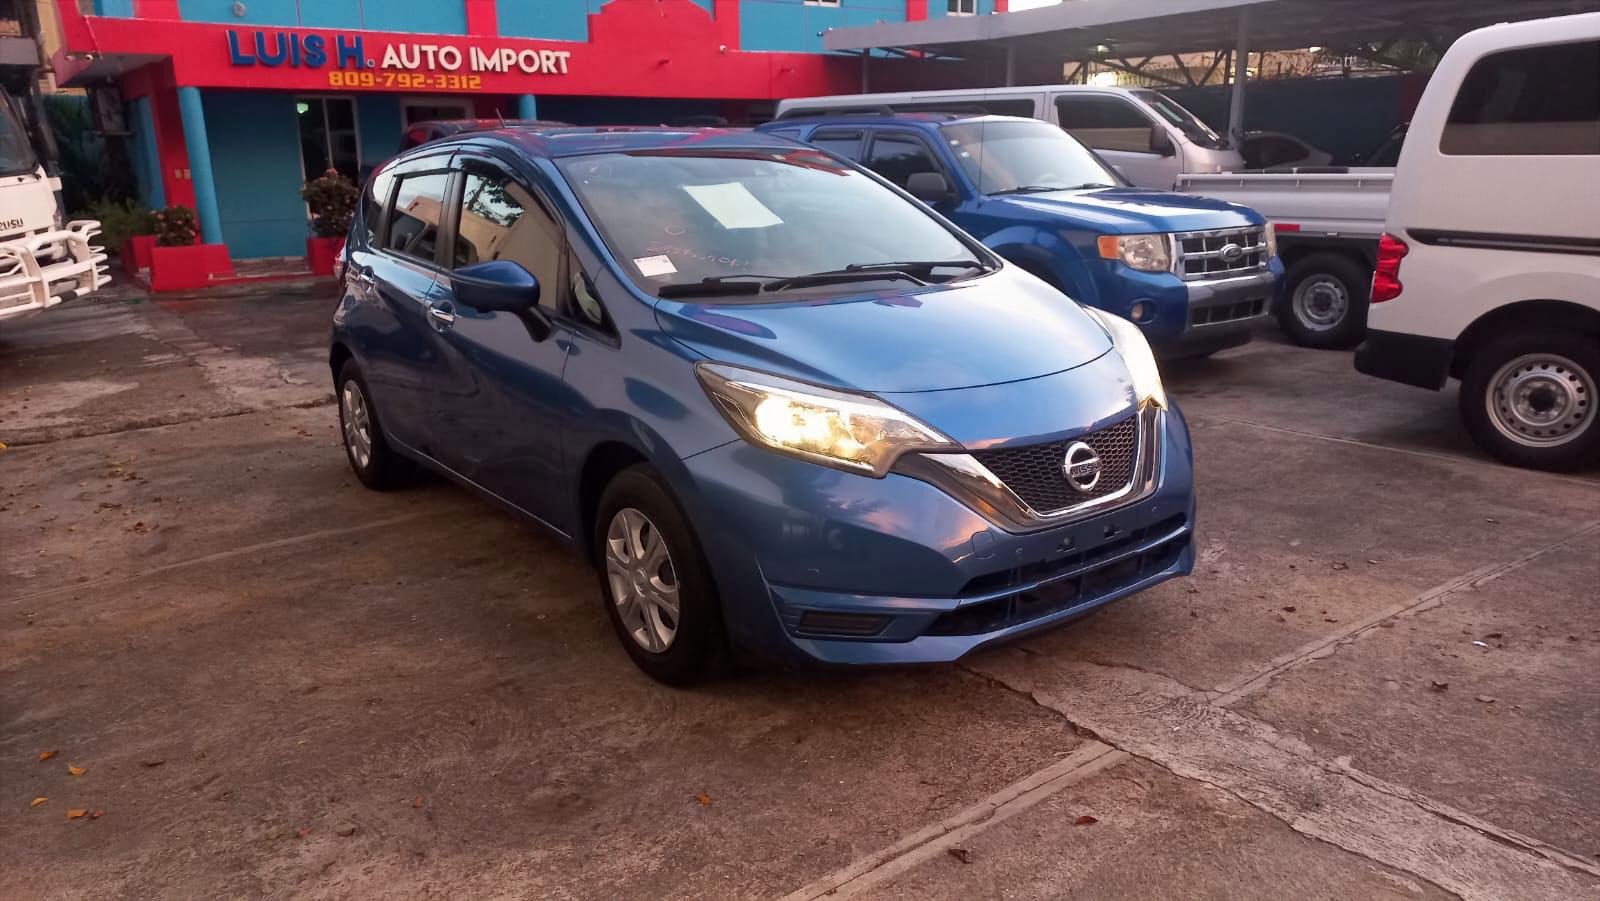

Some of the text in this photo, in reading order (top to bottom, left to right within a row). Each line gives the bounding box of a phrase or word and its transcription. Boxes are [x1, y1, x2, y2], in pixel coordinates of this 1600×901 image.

[227, 29, 571, 74] LUIS H. AUTO IMPORT
[328, 70, 482, 90] 809-792-3312
